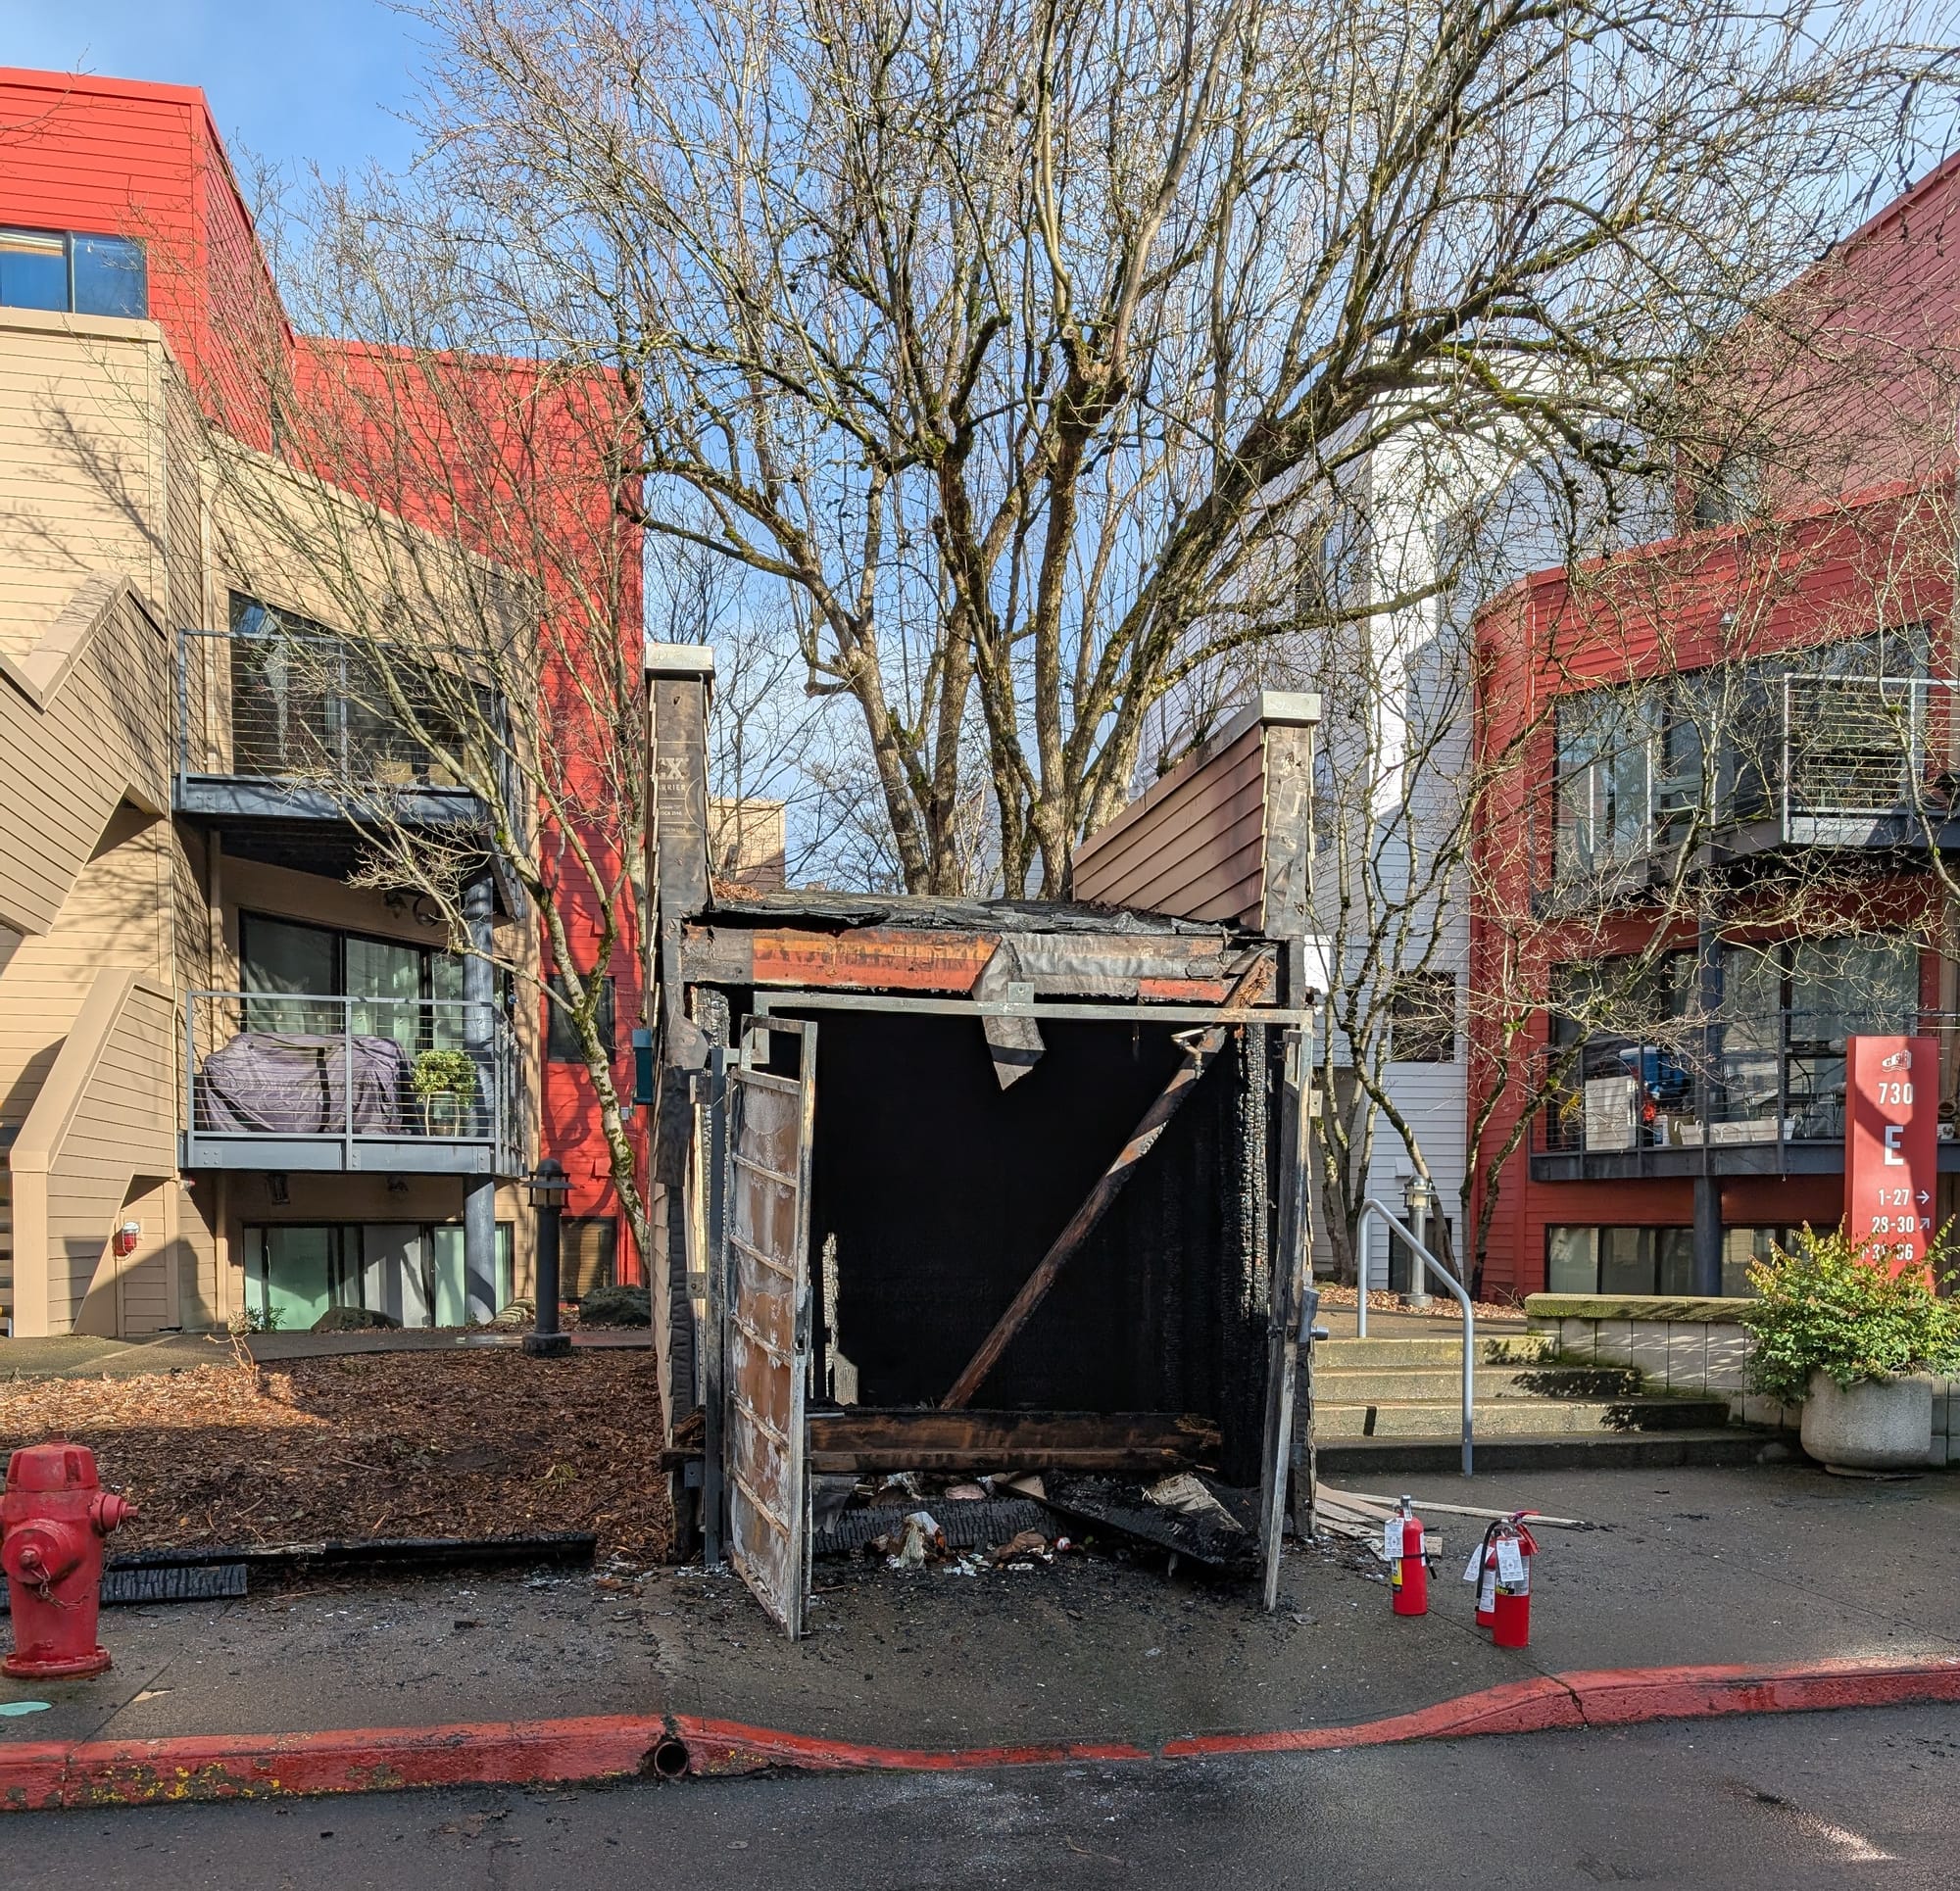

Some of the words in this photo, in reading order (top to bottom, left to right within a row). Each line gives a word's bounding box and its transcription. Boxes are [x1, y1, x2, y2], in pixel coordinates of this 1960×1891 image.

[1879, 1082, 1914, 1105] 730
[1885, 1125, 1904, 1166] E
[1878, 1188, 1910, 1206] 1-27
[1872, 1216, 1915, 1233] 28-30
